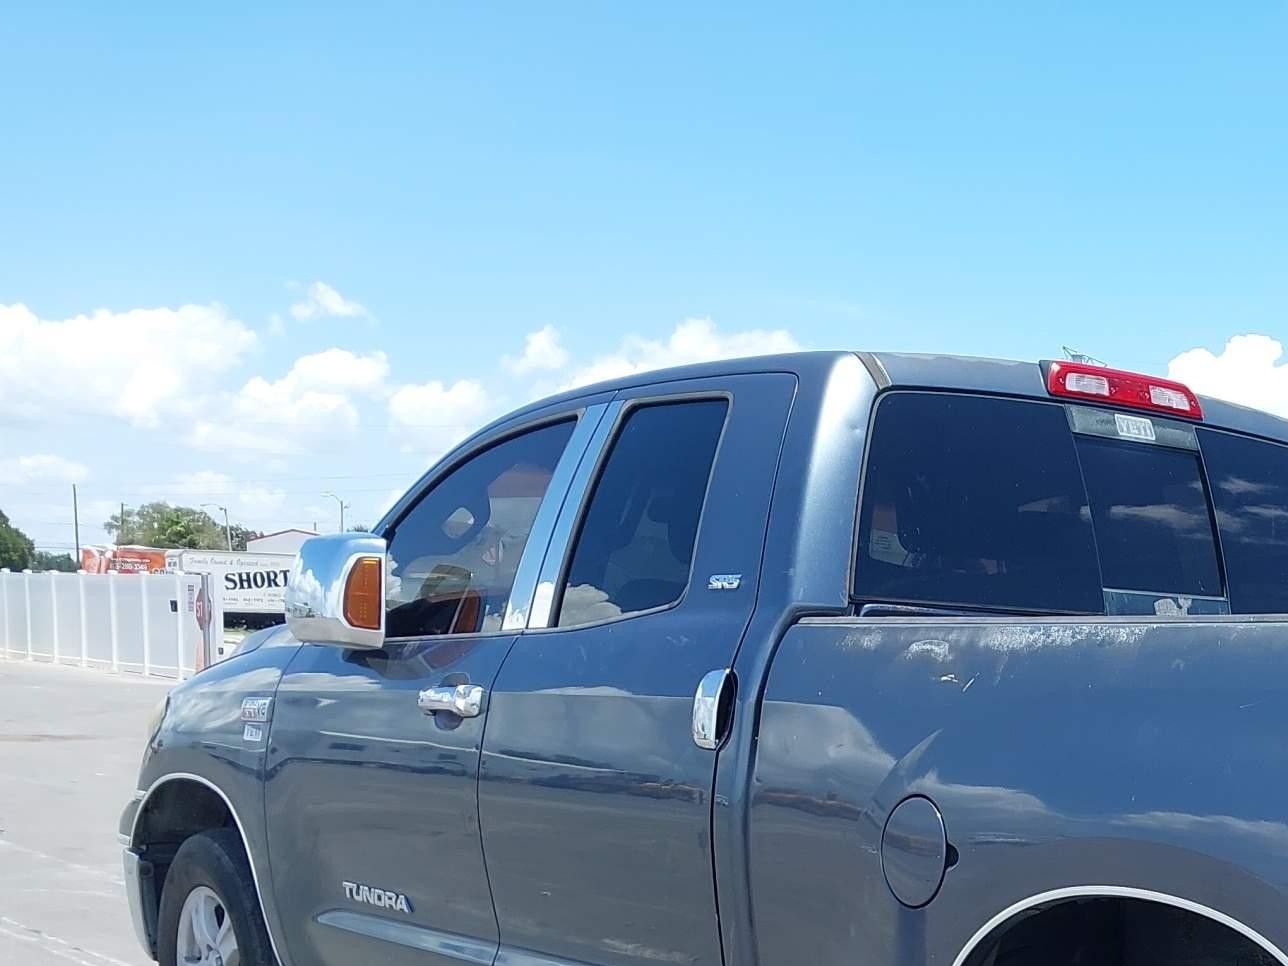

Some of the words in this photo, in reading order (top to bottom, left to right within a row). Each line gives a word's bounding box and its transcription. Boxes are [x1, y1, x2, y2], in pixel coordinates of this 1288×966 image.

[1117, 416, 1153, 438] YETI
[224, 569, 290, 590] SHORT
[707, 574, 742, 589] SR5
[342, 880, 410, 913] TUNDRA
